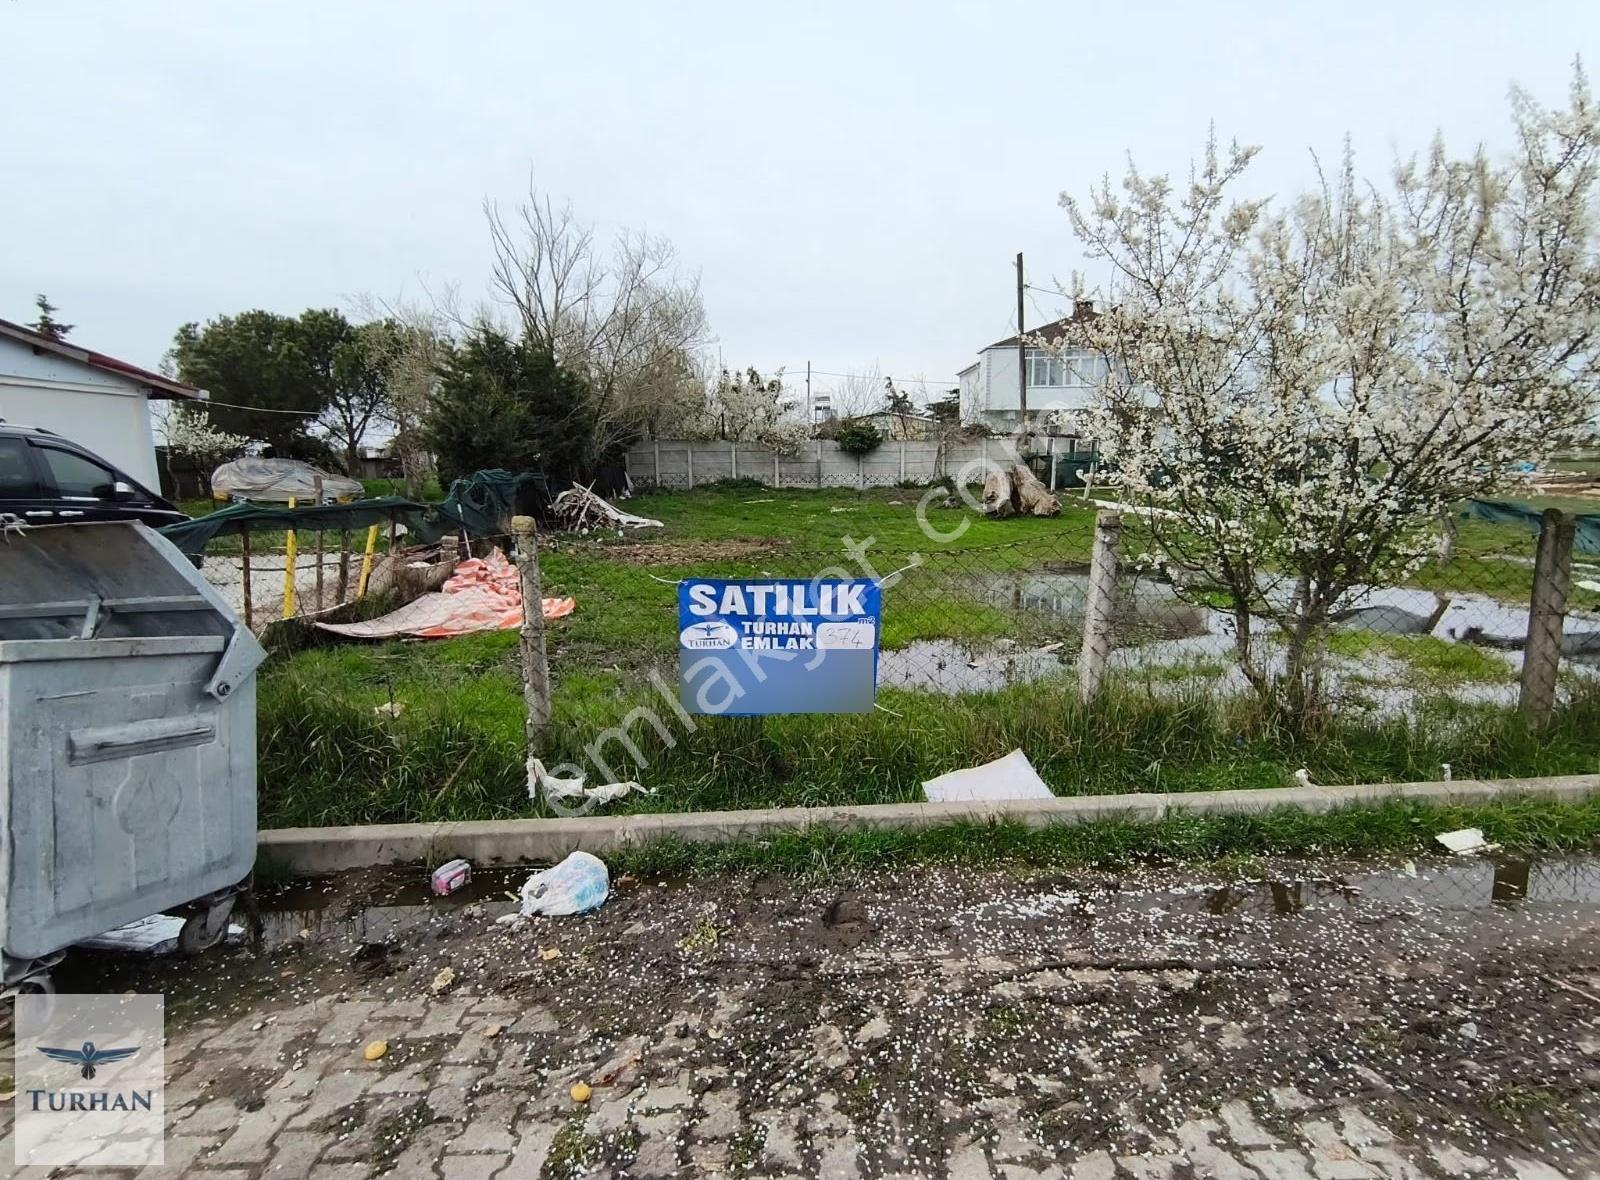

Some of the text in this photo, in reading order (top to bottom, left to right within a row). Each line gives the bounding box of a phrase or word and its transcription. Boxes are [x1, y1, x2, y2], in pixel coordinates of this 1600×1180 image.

[689, 584, 866, 616] SATILIK
[741, 621, 813, 635] TURHAN
[689, 638, 731, 648] TURHAN
[741, 637, 814, 650] EMLAK
[824, 626, 863, 649] 374
